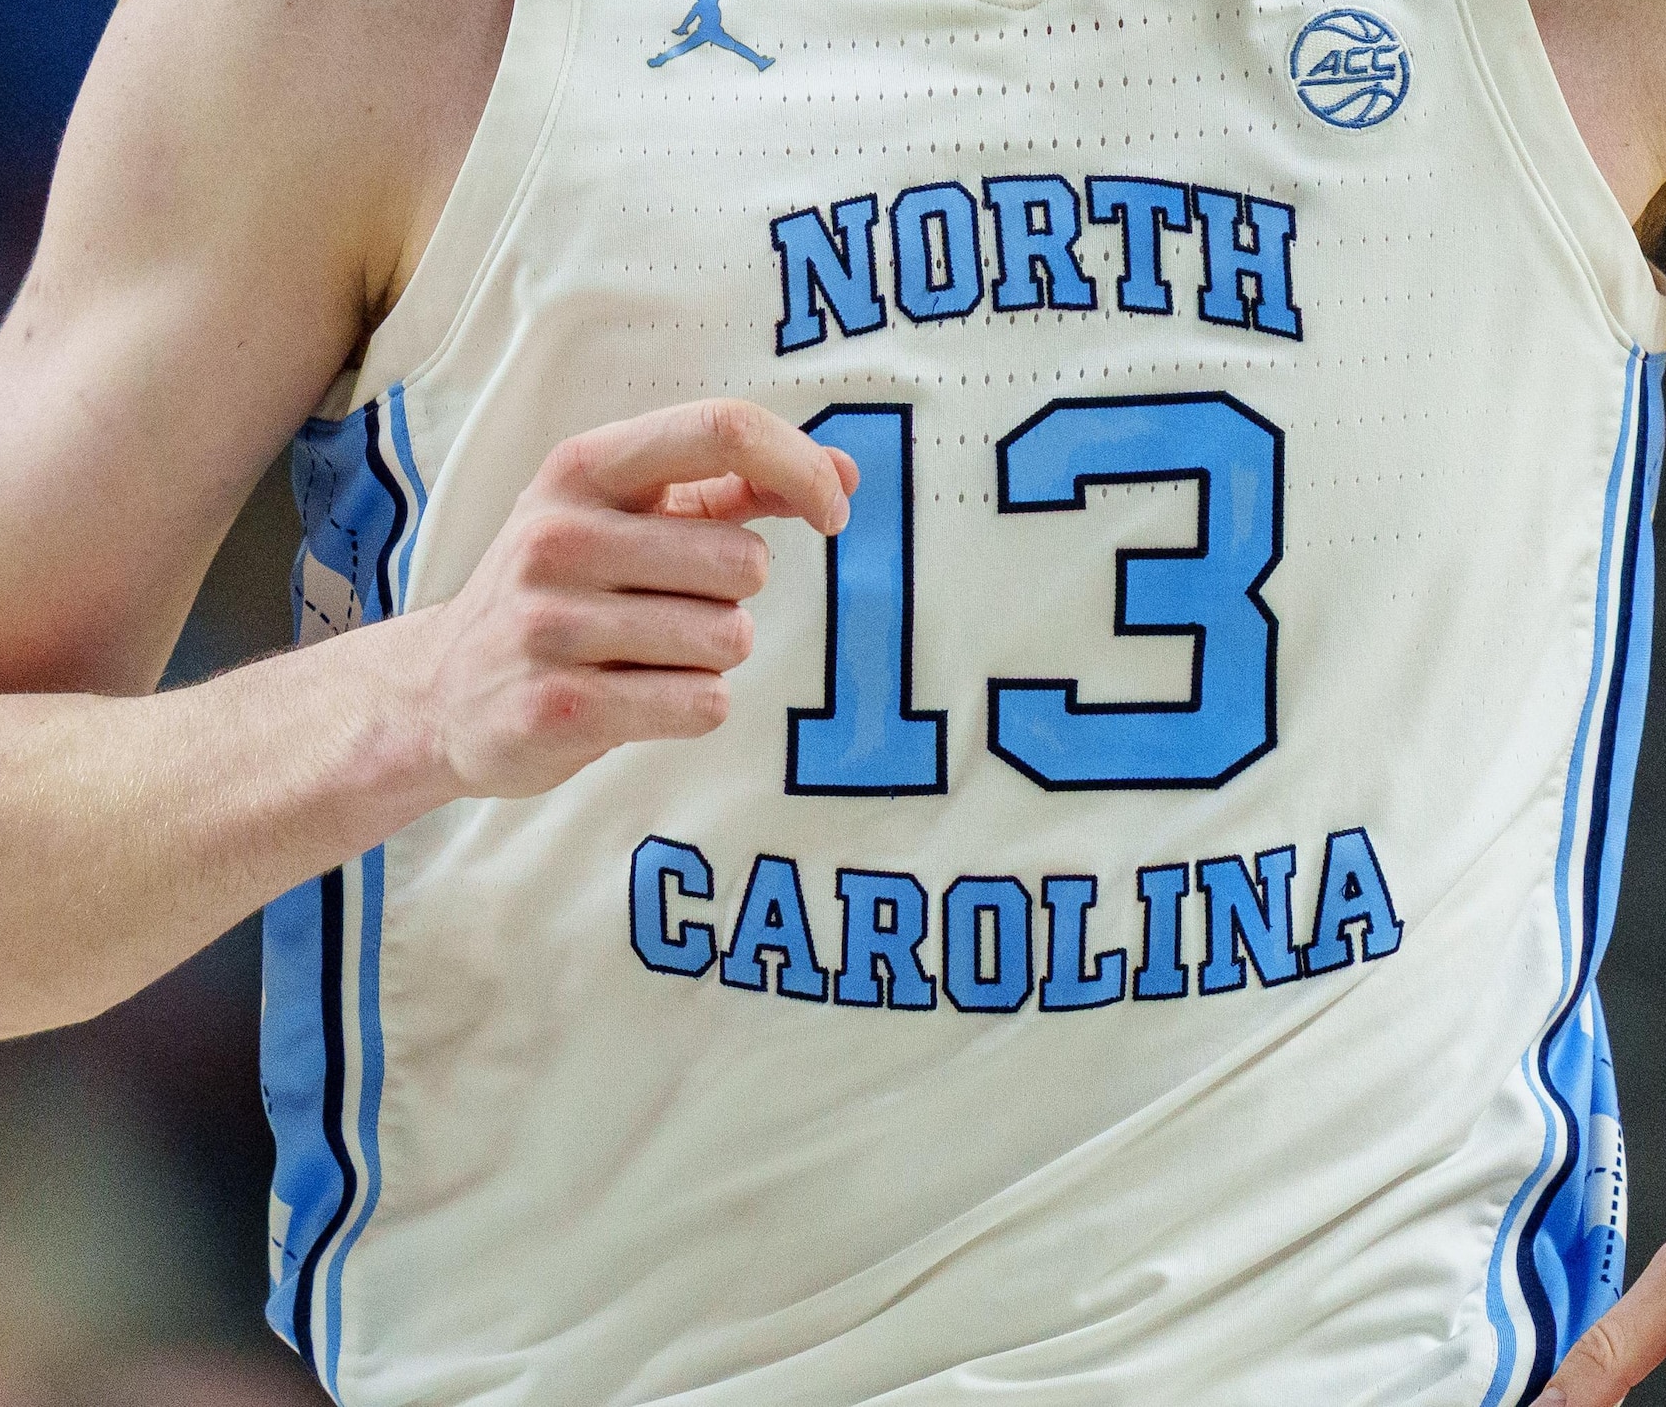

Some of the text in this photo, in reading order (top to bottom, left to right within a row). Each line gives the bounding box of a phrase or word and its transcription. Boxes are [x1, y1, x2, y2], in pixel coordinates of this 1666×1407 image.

[1306, 44, 1400, 76] ACC
[770, 174, 1303, 356] NORTH
[784, 391, 1285, 794] 13
[629, 826, 1404, 1013] CAROLINA
